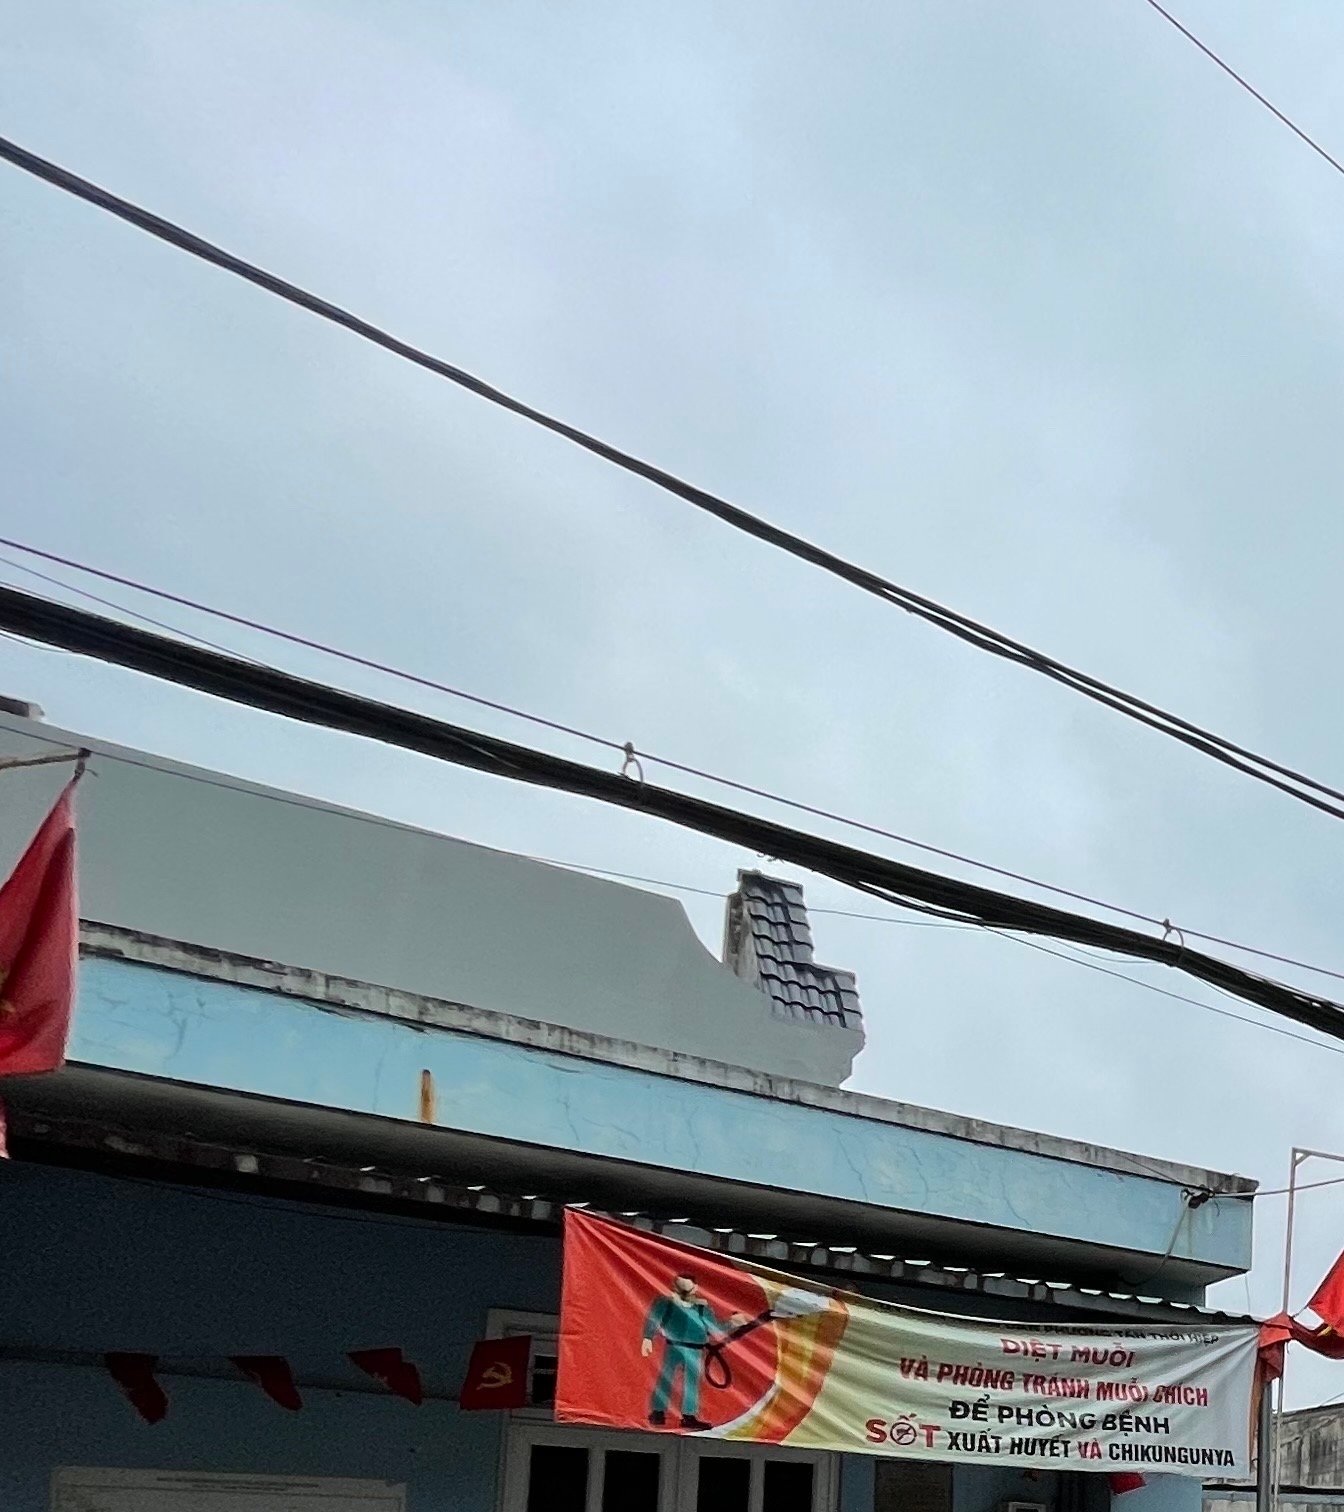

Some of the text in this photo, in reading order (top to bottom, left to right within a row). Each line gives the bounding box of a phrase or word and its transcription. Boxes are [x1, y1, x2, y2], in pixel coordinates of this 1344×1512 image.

[1000, 1338, 1062, 1362] DIỆT
[900, 1355, 1208, 1407] VÀ PHÒNG TRÁNH MUỖI CHÍCH
[949, 1394, 1170, 1437] ĐỂ PHÒNG BỆNH
[866, 1413, 1235, 1467] SỐT XUẤT HUYẾT VÀ CHIKUNGUNYA
